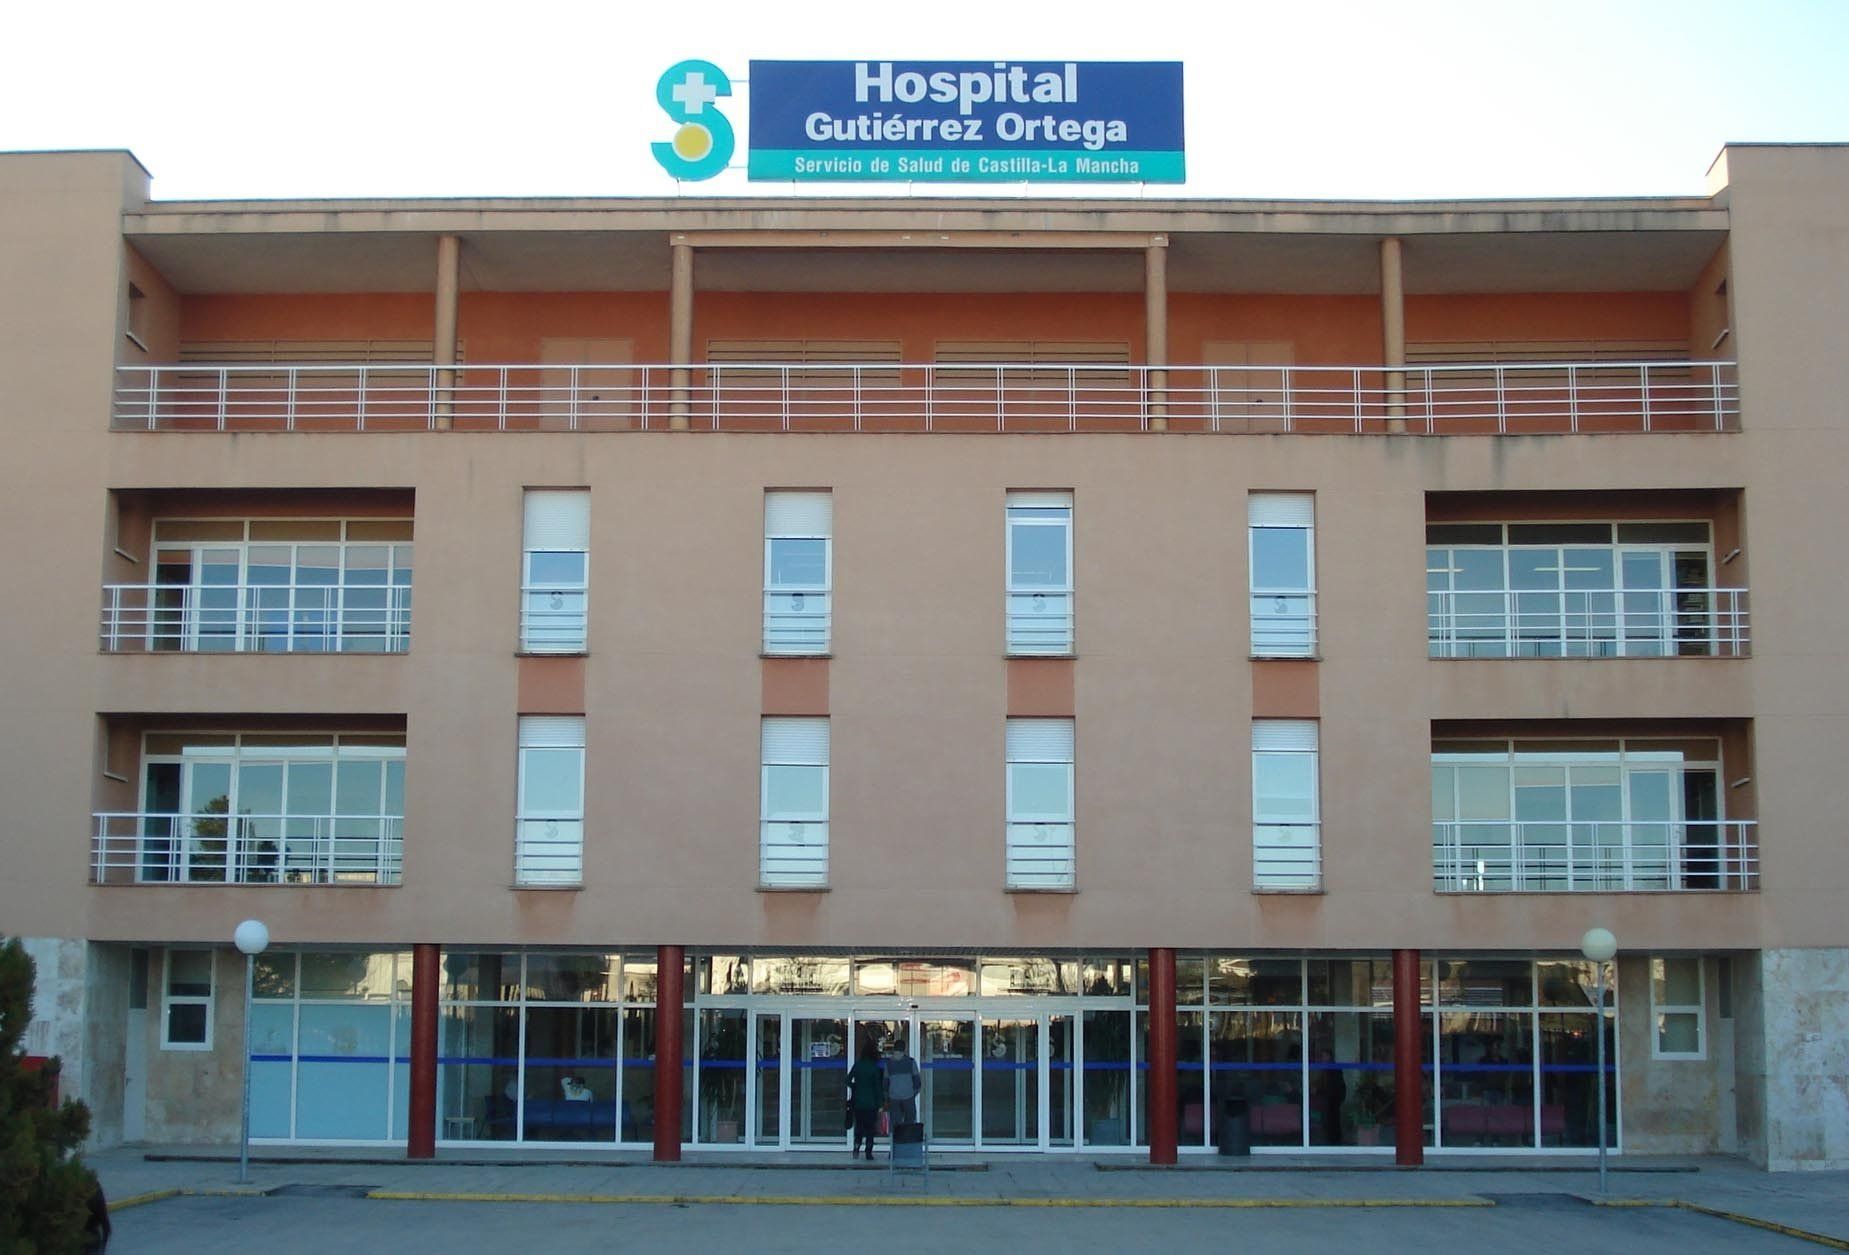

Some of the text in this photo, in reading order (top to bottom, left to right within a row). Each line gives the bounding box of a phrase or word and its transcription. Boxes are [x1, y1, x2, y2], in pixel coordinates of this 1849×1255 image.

[854, 62, 1079, 115] Hospital
[805, 111, 1127, 149] Gutiérrez Ortega
[795, 156, 1140, 174] Servicio de Salud de Castilla-La Mancha
